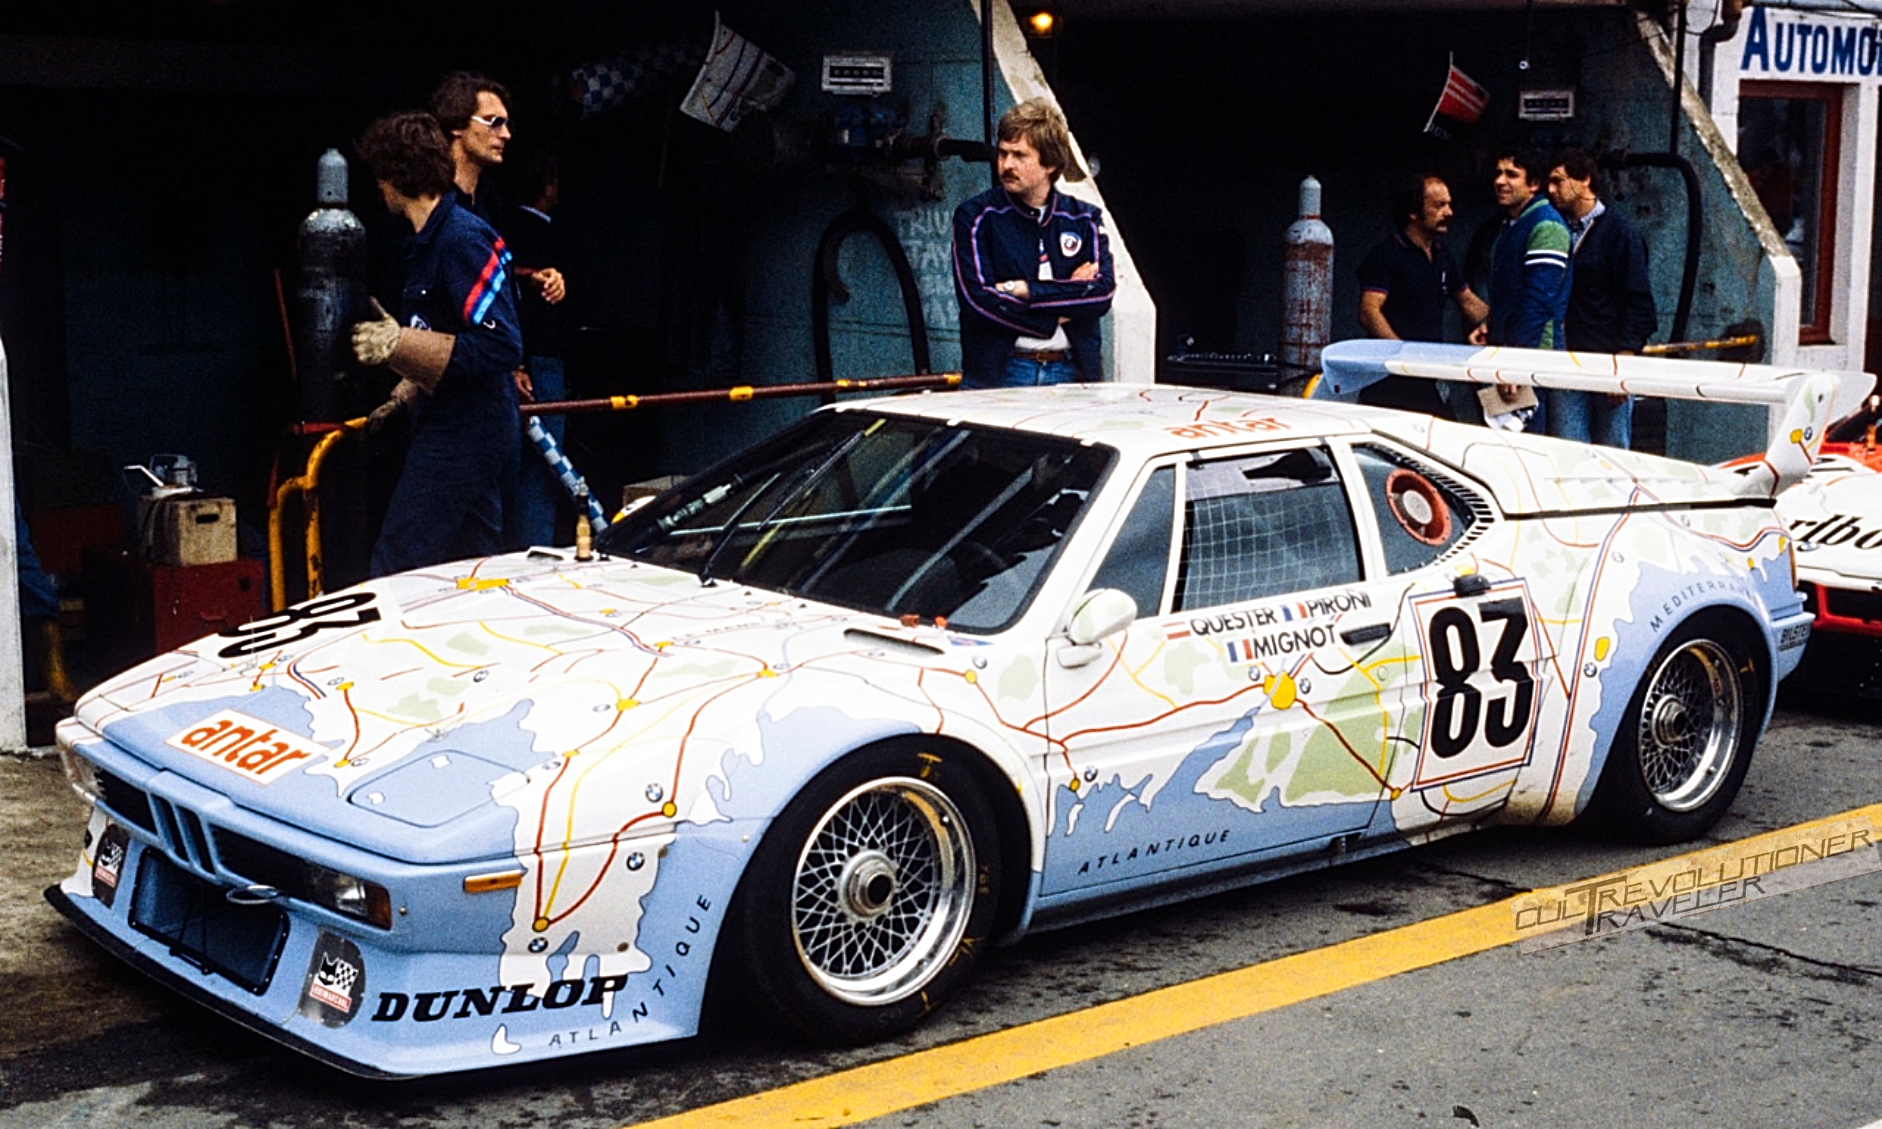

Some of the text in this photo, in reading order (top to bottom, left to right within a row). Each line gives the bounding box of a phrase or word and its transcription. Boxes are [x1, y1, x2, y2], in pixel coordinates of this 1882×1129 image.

[1164, 418, 1291, 437] antar
[1190, 590, 1371, 635] QUESTER PIRONI
[1253, 624, 1335, 659] MIGNOT
[1429, 597, 1534, 758] 83
[181, 719, 313, 775] antar
[1077, 829, 1230, 875] ATLANTIQUE
[549, 895, 712, 1046] ATLANTIQUE
[371, 974, 629, 1022] DUNLOP
